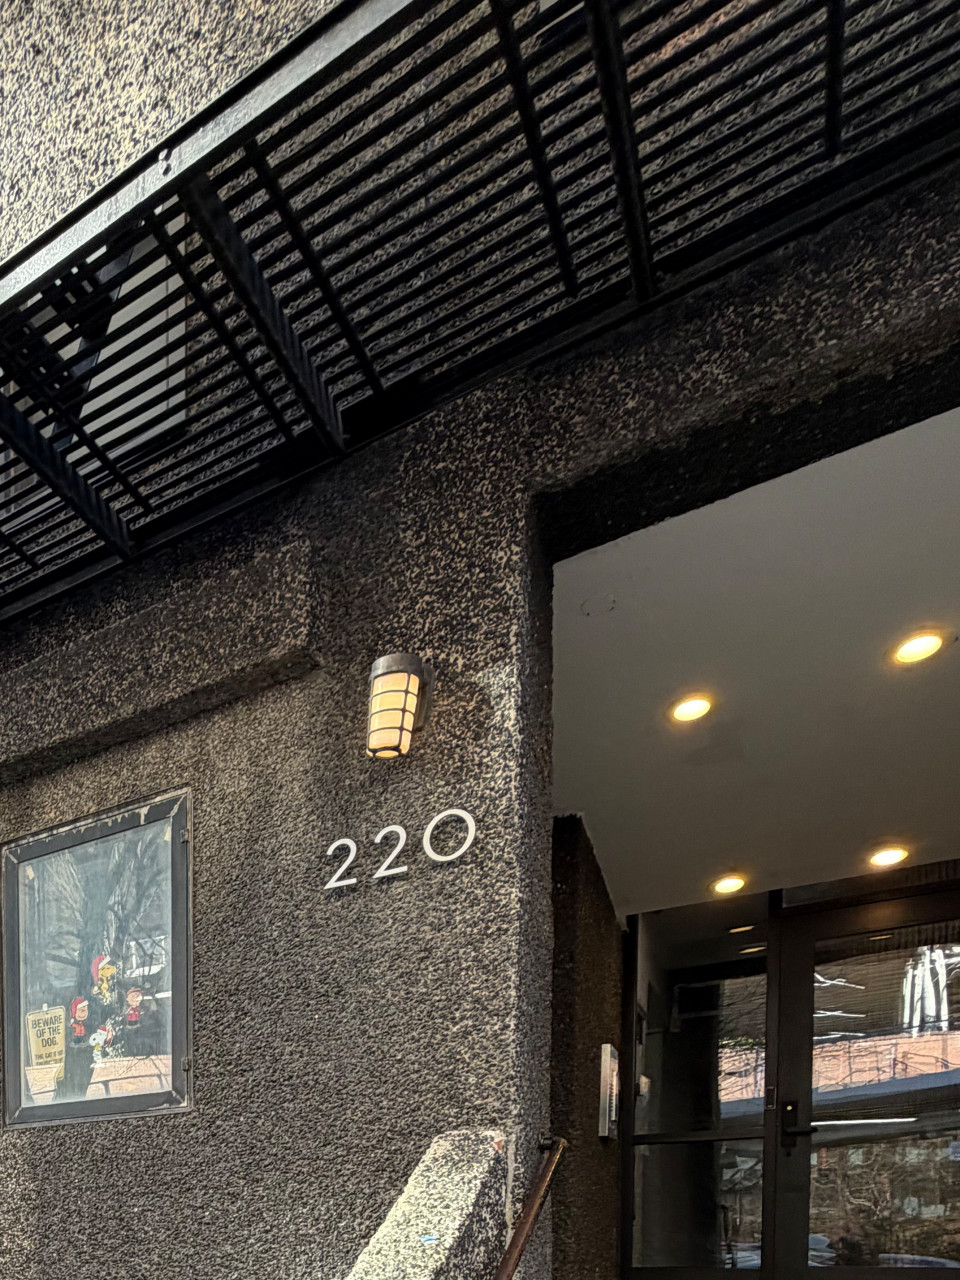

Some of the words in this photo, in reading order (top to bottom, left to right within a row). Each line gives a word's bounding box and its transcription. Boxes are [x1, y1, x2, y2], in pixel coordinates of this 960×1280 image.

[324, 808, 476, 890] 220
[31, 1015, 63, 1029] BEWARE
[36, 1028, 46, 1038] OF
[47, 1025, 61, 1036] THE
